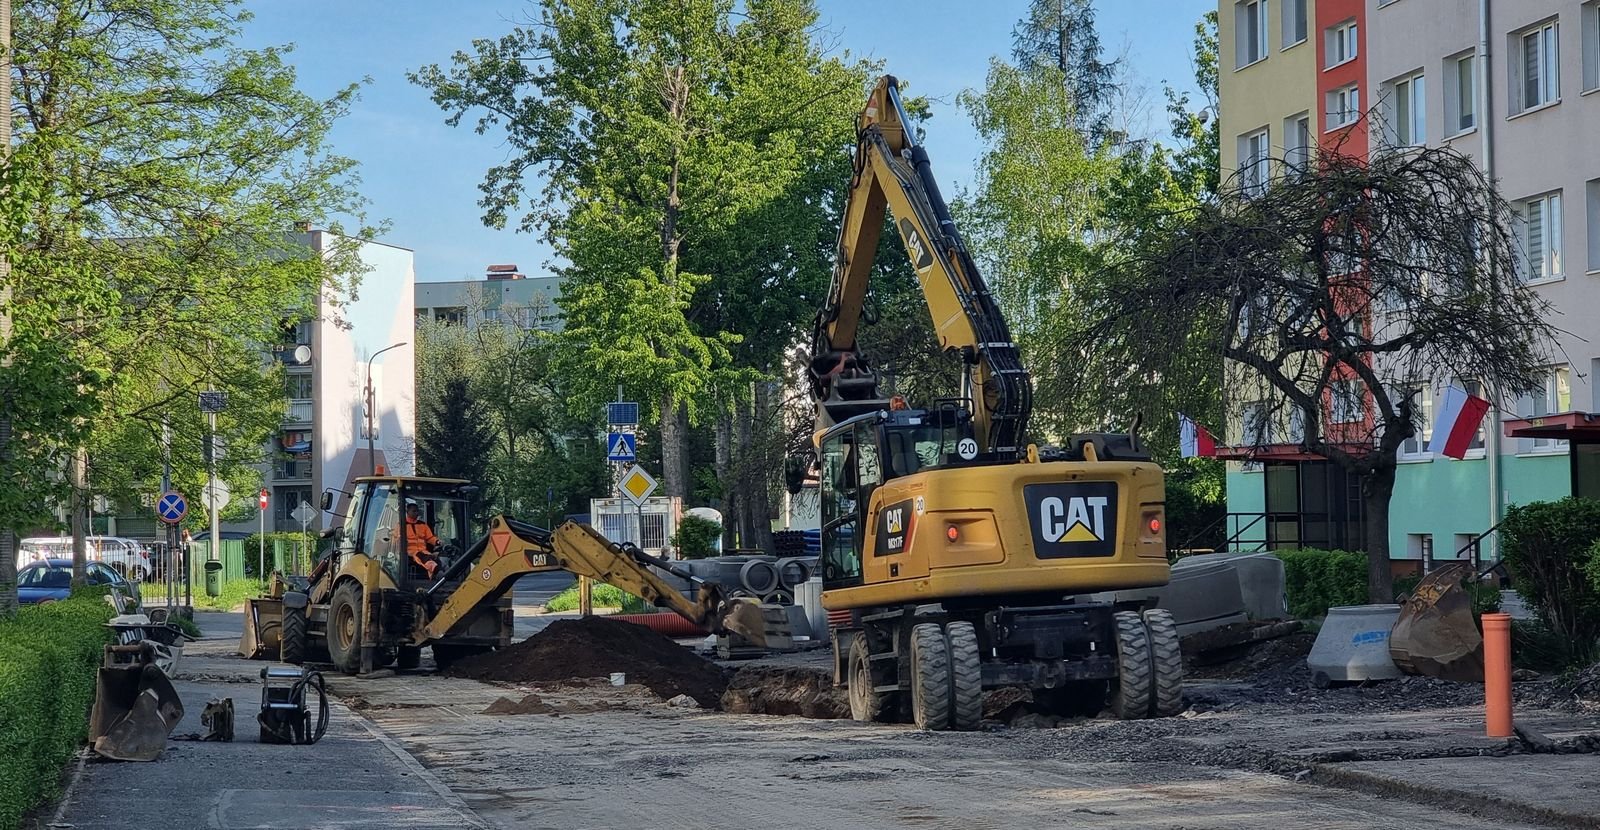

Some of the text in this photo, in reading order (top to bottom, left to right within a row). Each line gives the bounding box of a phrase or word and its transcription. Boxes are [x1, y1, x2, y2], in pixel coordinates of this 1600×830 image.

[909, 231, 924, 264] CAT
[960, 442, 976, 454] 20
[917, 499, 923, 511] 20
[887, 508, 903, 534] CAT
[1041, 496, 1108, 543] CAT
[533, 554, 547, 566] CAT
